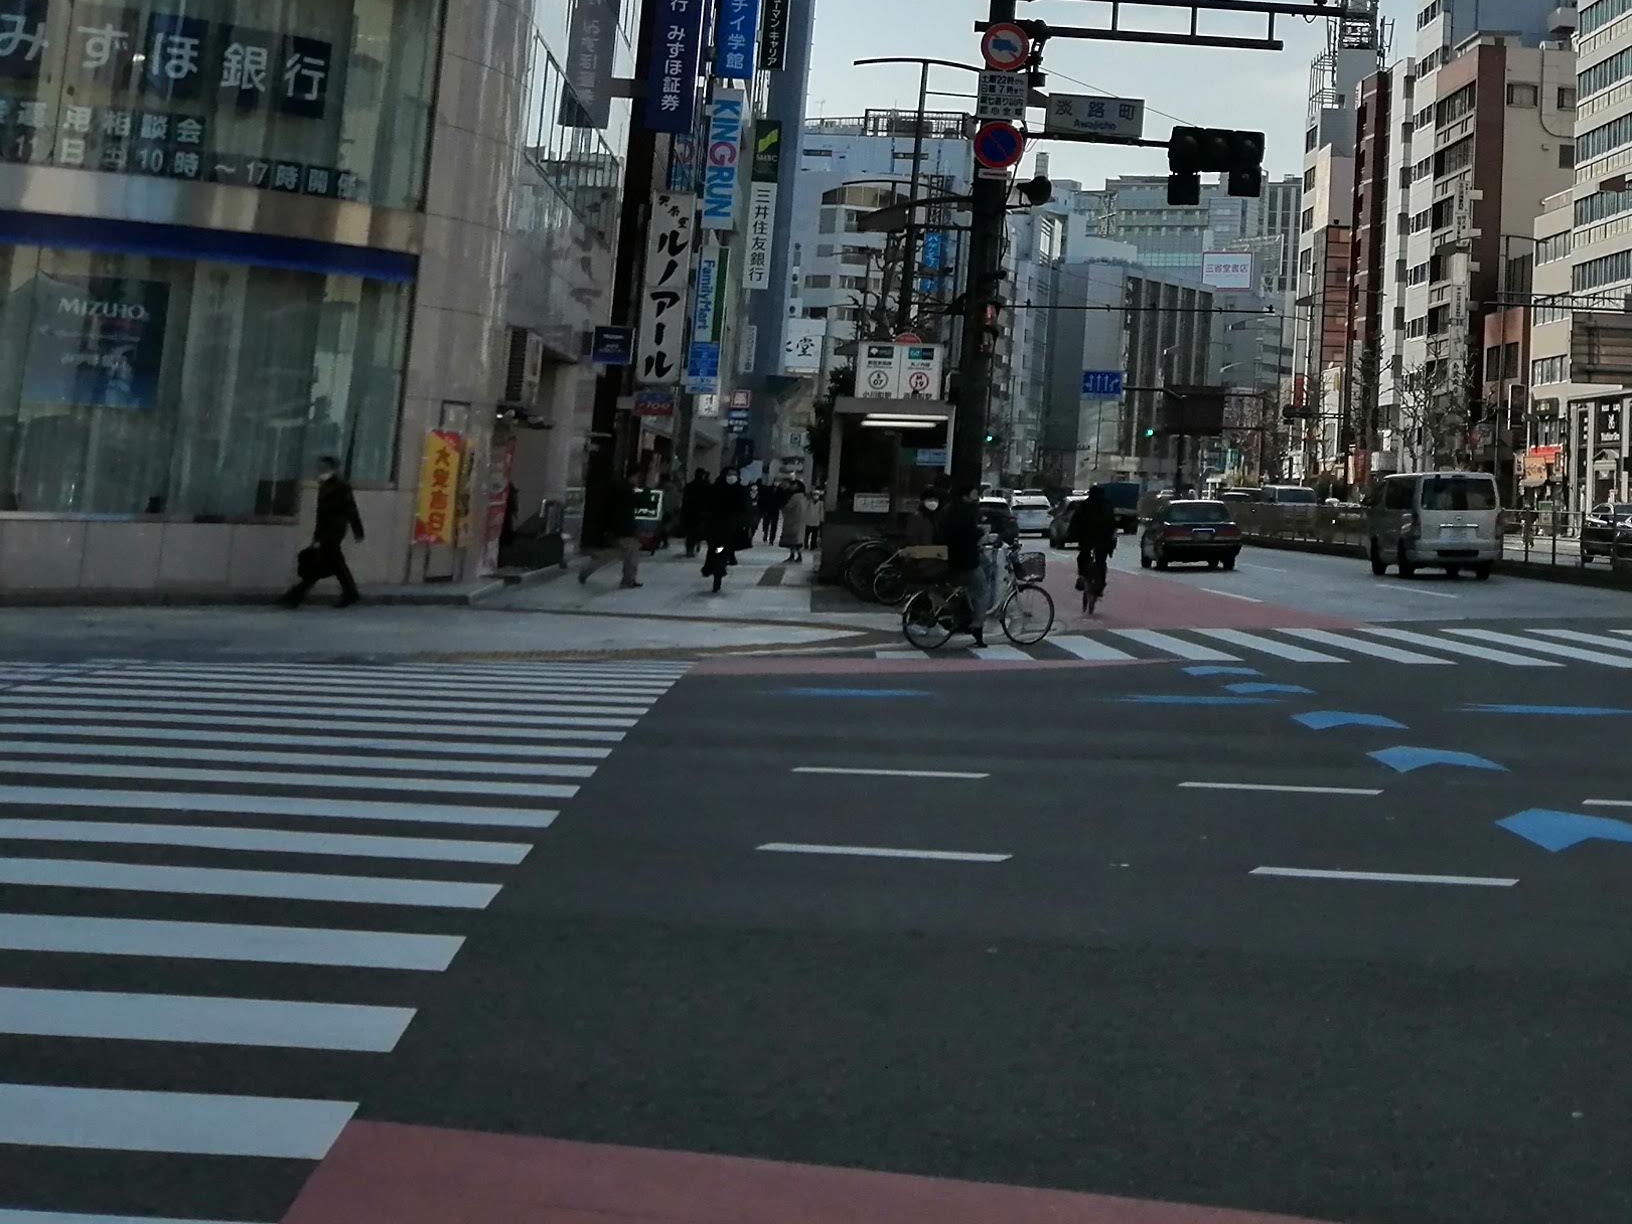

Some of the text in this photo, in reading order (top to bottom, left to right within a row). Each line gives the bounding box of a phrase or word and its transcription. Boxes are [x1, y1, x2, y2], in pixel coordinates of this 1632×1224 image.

[0, 12, 326, 101] みずほ銀行
[660, 25, 687, 112] みずほ証券
[1056, 99, 1136, 121] 淡路町
[704, 99, 741, 219] KINGRUN
[749, 189, 771, 282] 三井住友銀行
[644, 229, 689, 378] ルノアール
[698, 260, 715, 329] FamilyMart
